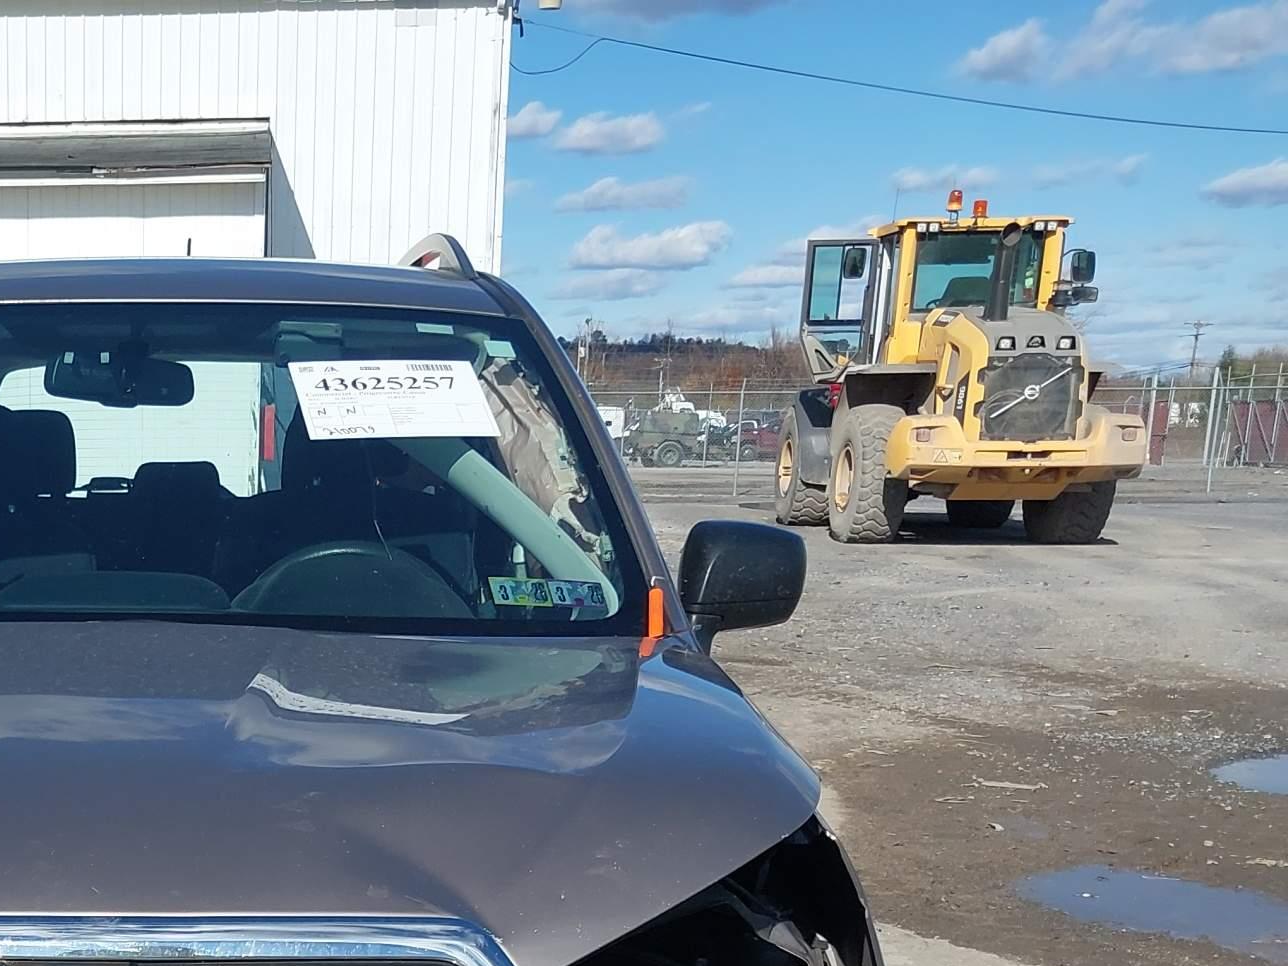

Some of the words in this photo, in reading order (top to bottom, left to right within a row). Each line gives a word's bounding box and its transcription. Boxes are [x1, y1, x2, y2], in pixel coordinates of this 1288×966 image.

[314, 376, 454, 391] 43625257
[498, 585, 510, 601] 3
[555, 586, 567, 602] 3
